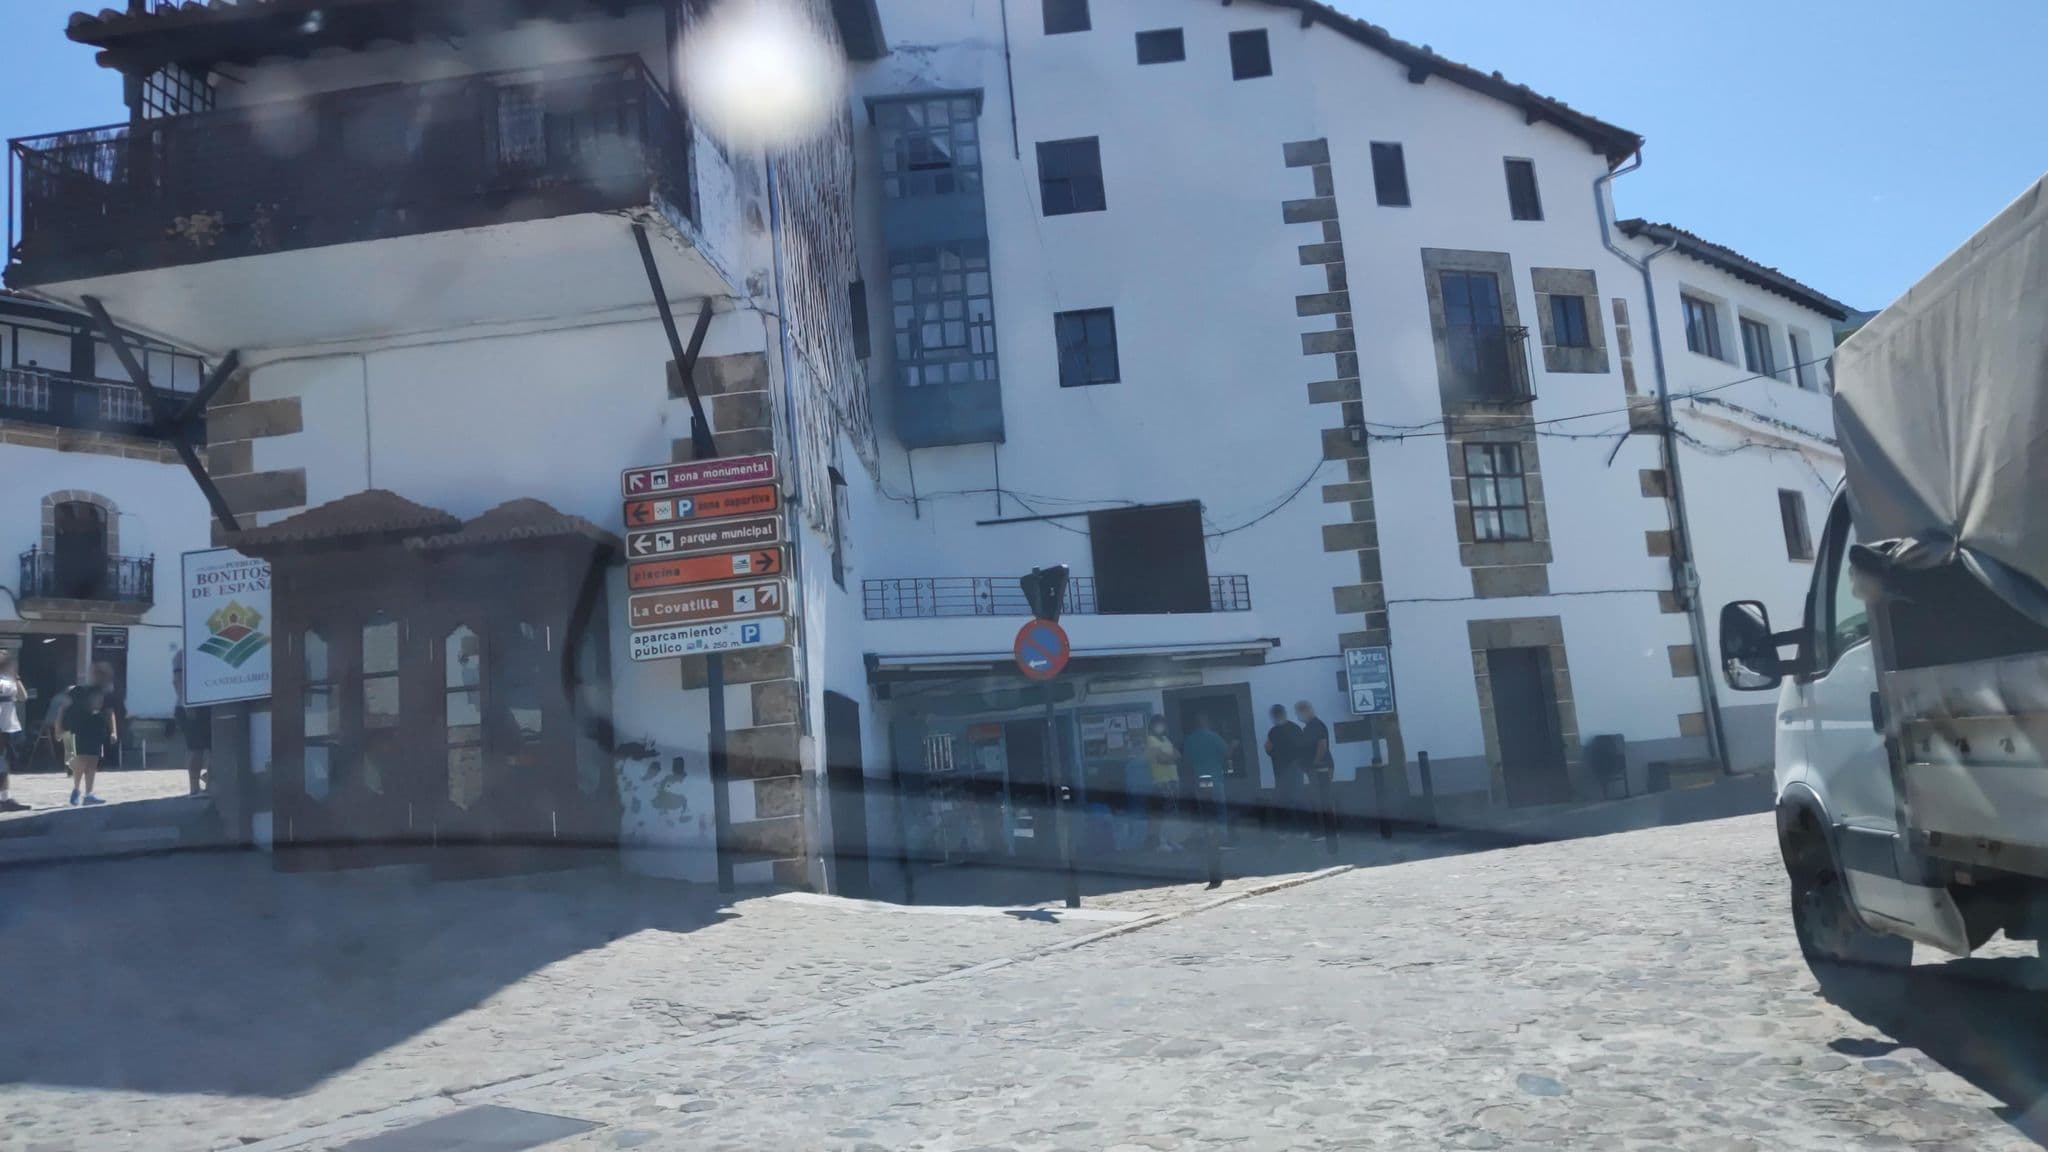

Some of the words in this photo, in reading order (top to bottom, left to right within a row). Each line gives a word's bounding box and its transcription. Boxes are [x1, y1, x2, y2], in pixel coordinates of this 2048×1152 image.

[674, 468, 698, 483] zona
[703, 461, 769, 479] monumental
[678, 500, 693, 517] P
[698, 500, 721, 511] zona
[724, 493, 771, 509] deportiva
[680, 532, 718, 546] parque
[722, 523, 773, 540] municipal
[196, 565, 271, 585] BONITOS
[634, 567, 681, 582] piscina
[192, 587, 212, 599] DE
[219, 578, 271, 595] ESPAÑ
[633, 607, 649, 617] La
[654, 598, 719, 615] Covatilla
[634, 625, 722, 645] aparcamiento
[634, 643, 683, 659] público
[713, 641, 728, 650] 250
[1348, 650, 1385, 665] HOTEL
